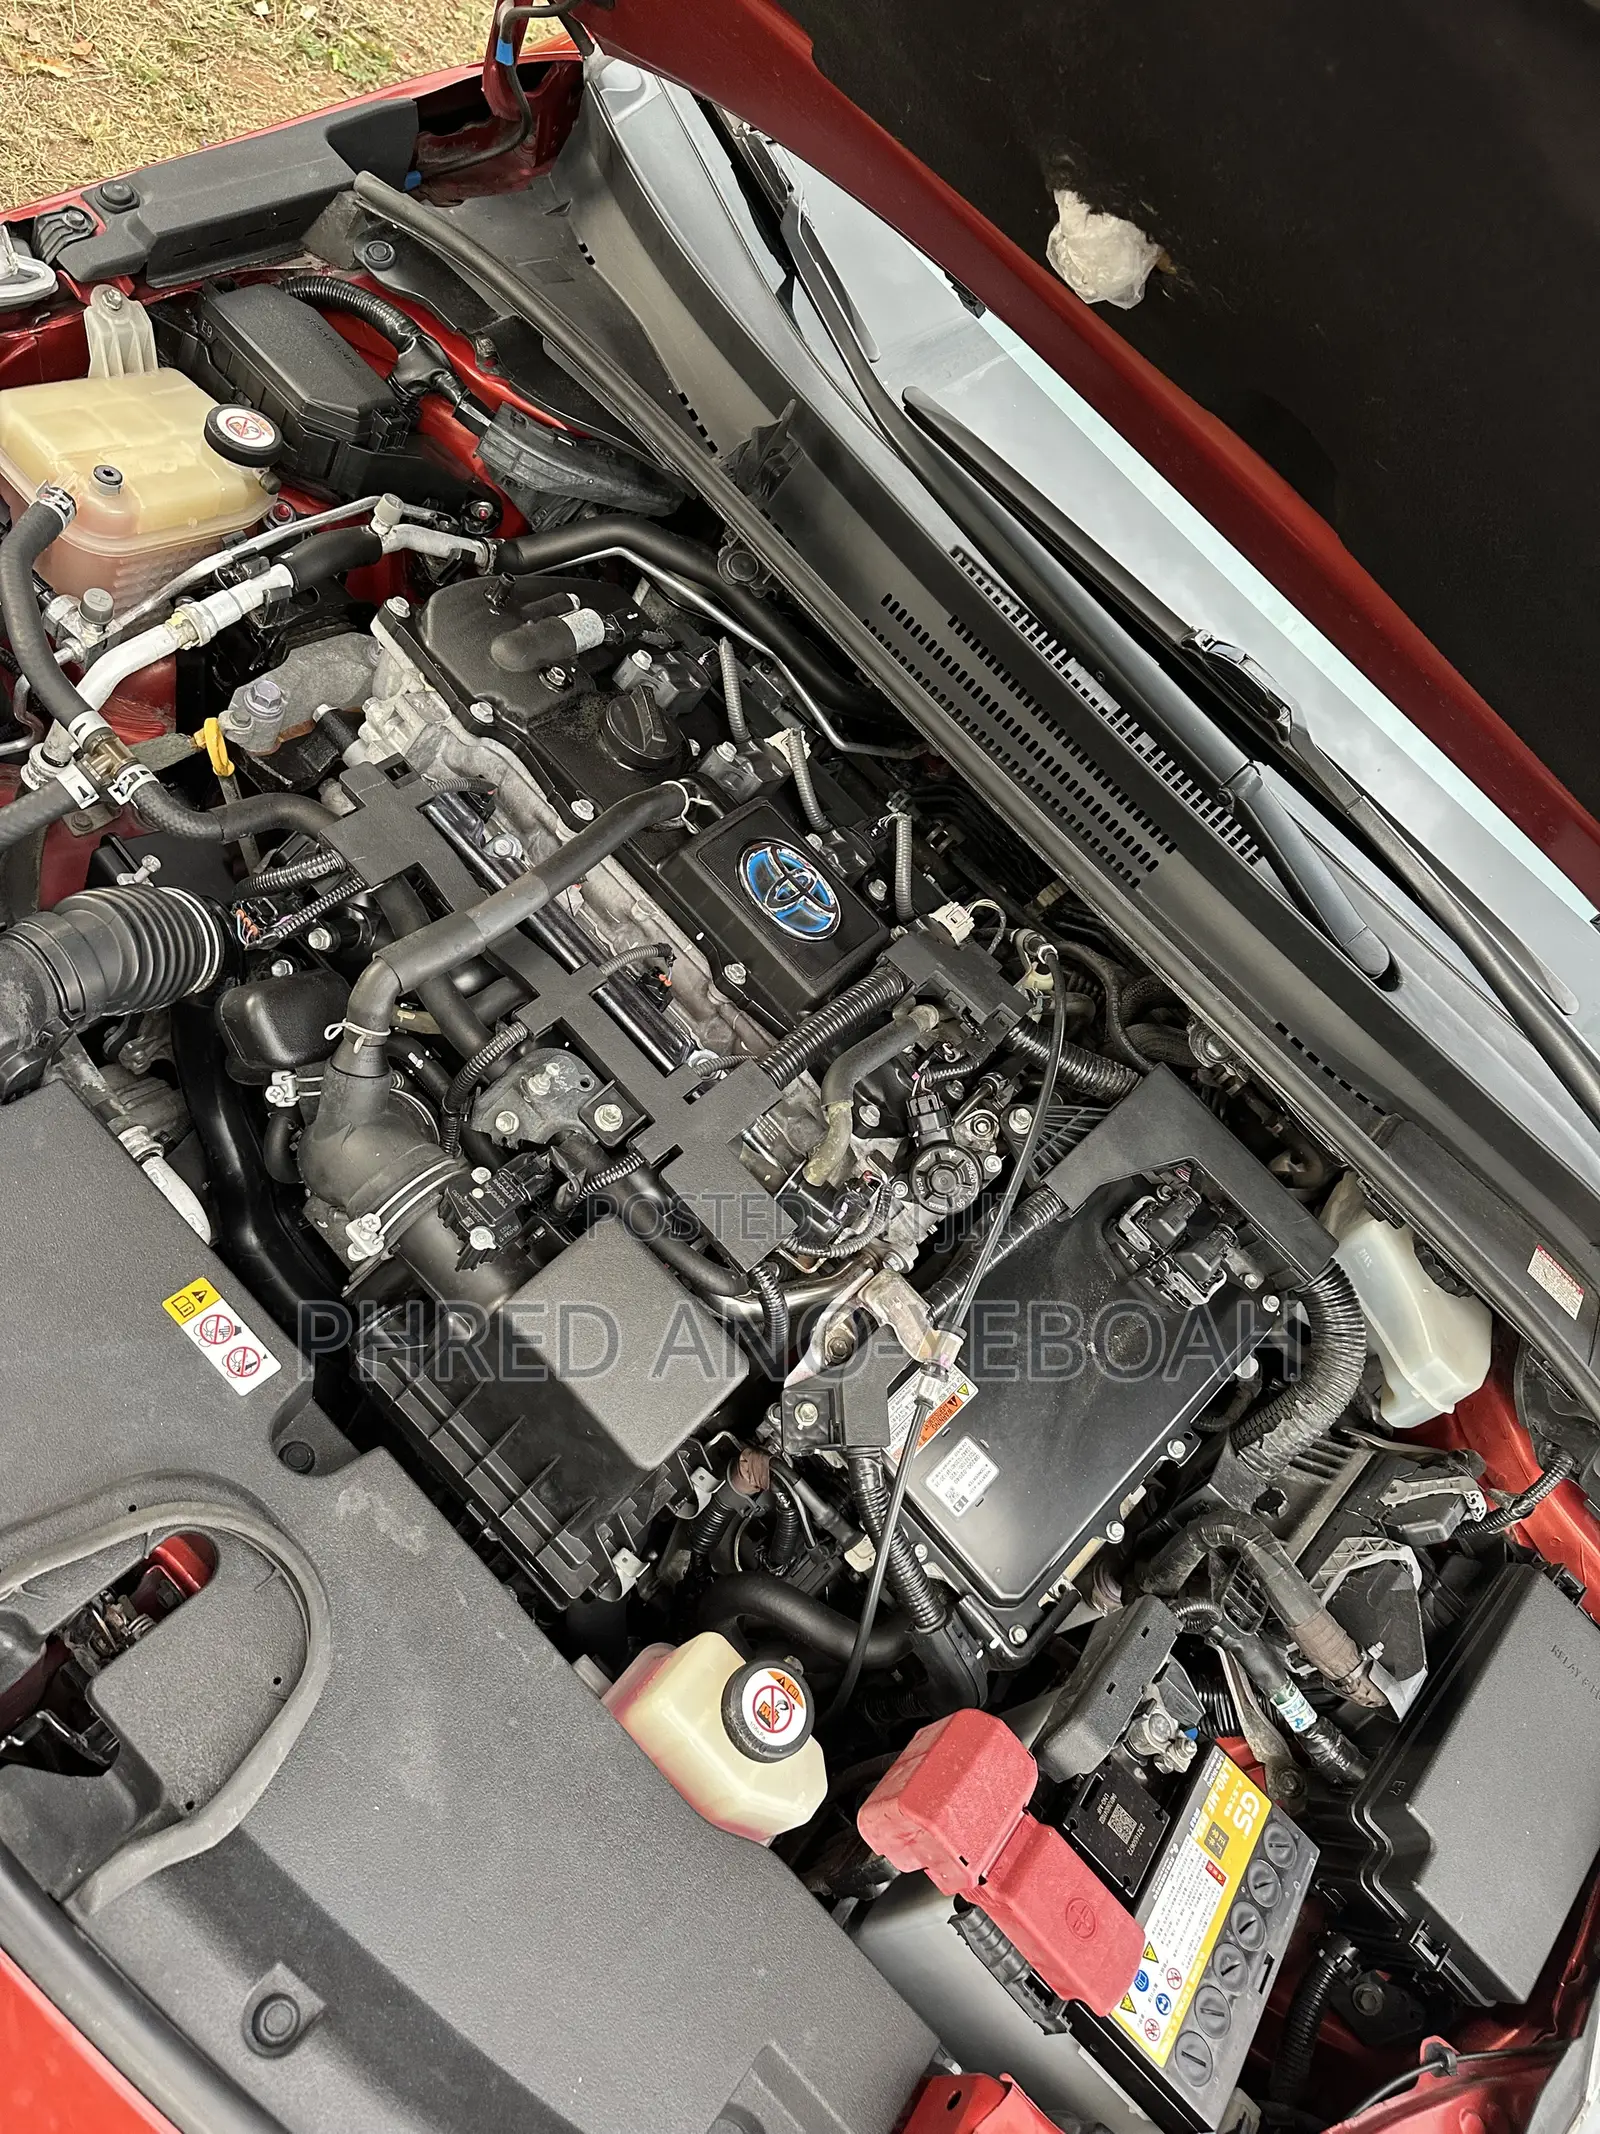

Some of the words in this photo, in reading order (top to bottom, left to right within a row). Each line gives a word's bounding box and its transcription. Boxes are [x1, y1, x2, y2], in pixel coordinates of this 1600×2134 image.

[201, 319, 213, 339] E9
[484, 1181, 508, 1209] TOYOTA
[930, 1406, 953, 1431] WARNING
[1551, 1644, 1581, 1678] RELAY
[1232, 1790, 1261, 1838] GS
